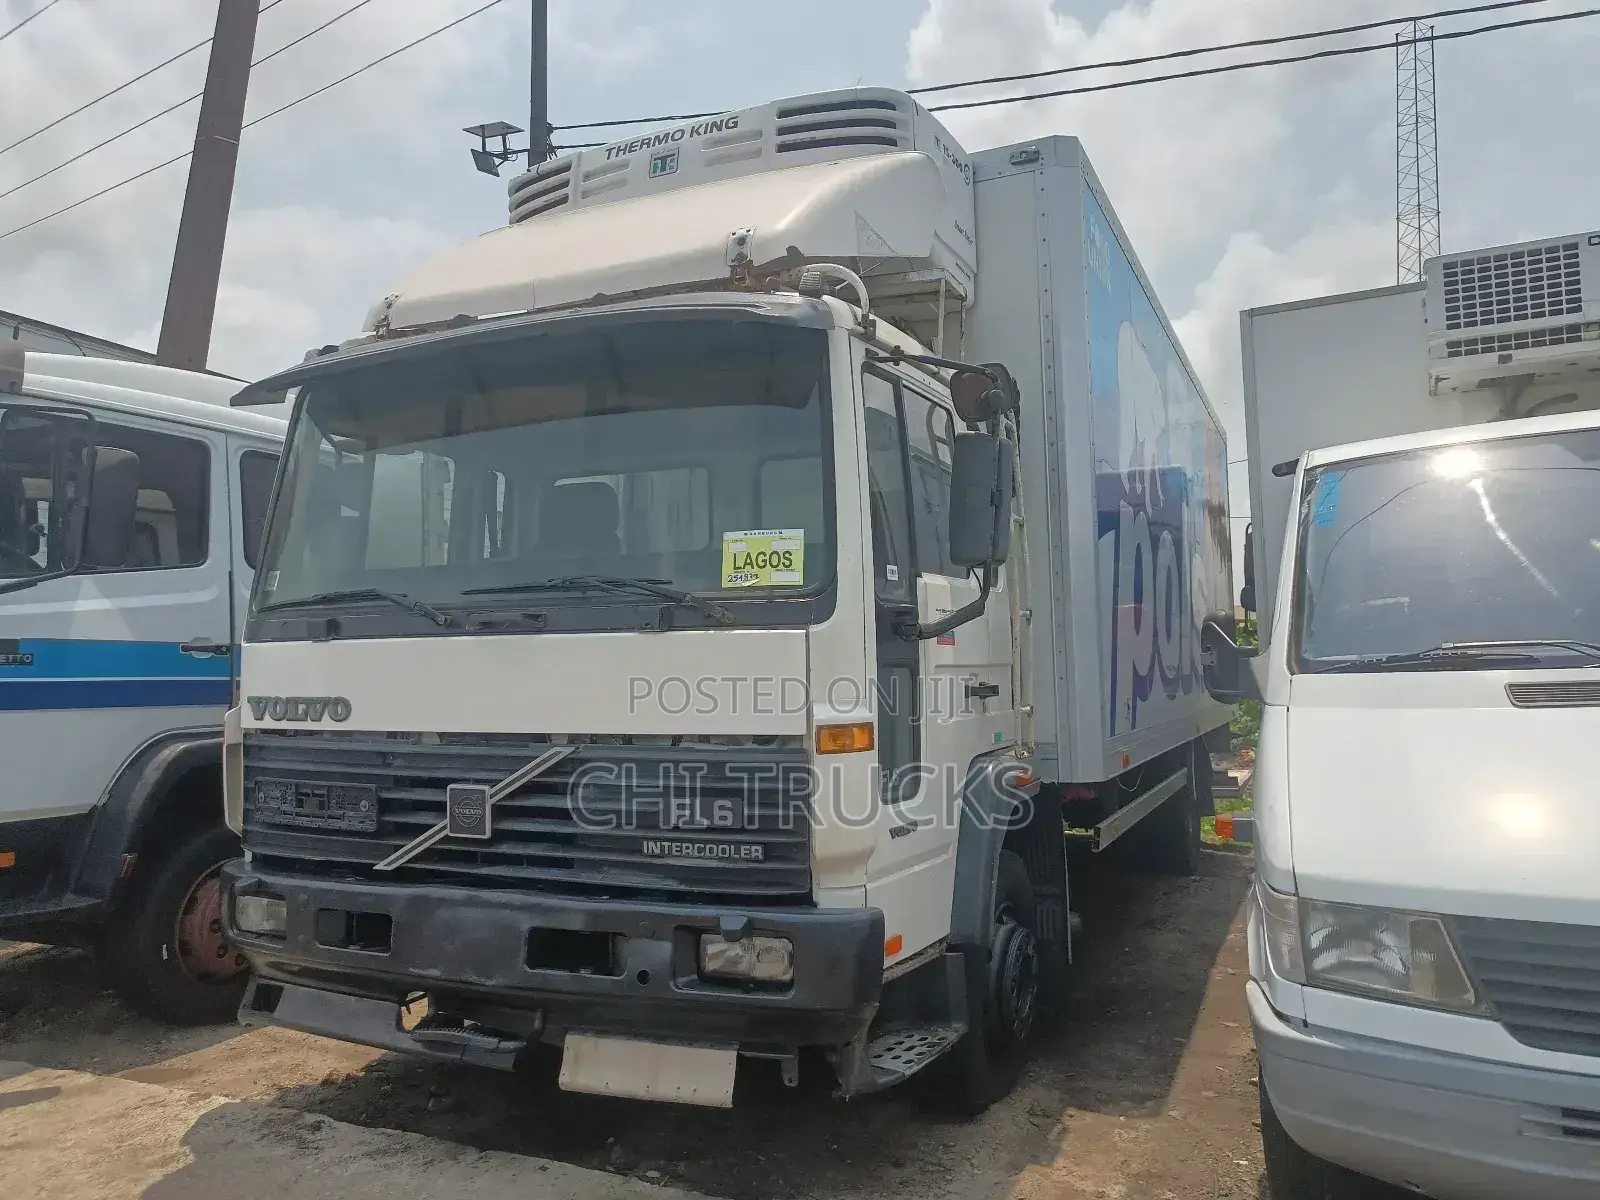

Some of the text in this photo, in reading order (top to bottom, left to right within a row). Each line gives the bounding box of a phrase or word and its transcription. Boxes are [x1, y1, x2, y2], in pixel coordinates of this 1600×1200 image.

[605, 115, 740, 160] THERMO KING
[733, 550, 793, 571] LAGOS
[247, 696, 352, 722] VOLVO
[643, 840, 764, 860] INTERCOOLER
